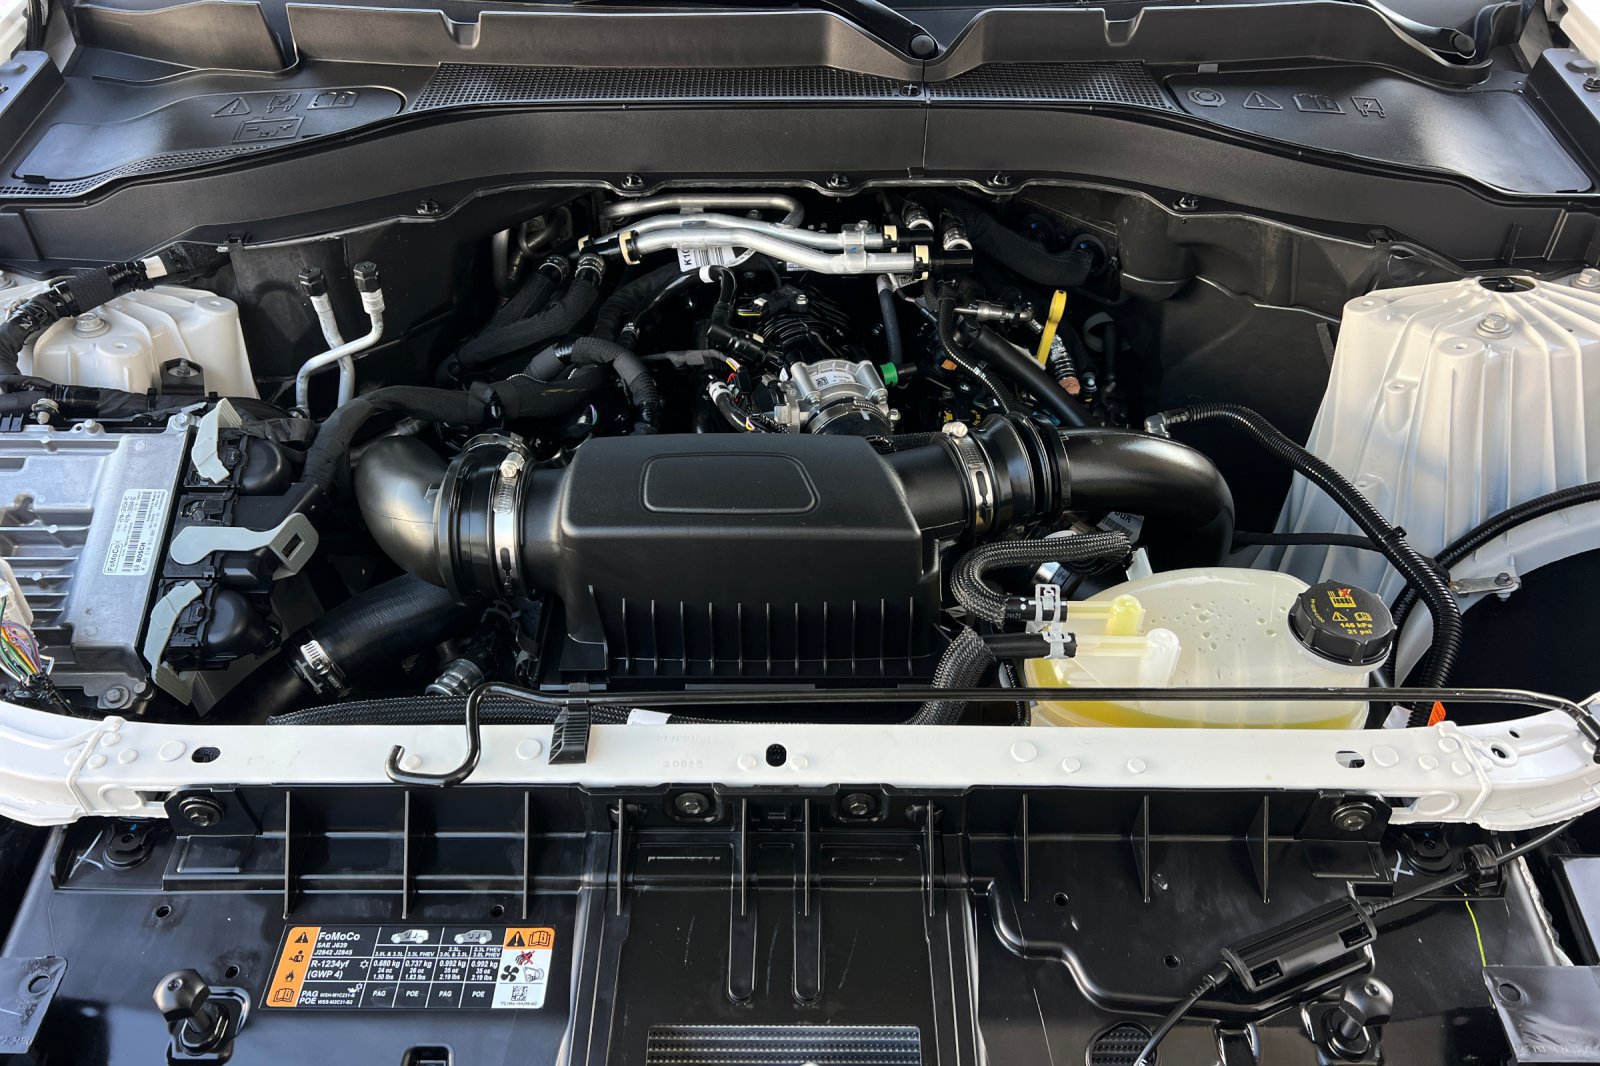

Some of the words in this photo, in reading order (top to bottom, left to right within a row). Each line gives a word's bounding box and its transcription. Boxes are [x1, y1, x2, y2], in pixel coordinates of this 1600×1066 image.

[136, 542, 146, 563] BOSCH
[108, 544, 120, 571] FoMoCo
[318, 932, 360, 941] FoMoCo
[311, 959, 350, 969] R-1234yf
[391, 960, 400, 968] kg
[423, 960, 432, 968] kg
[457, 960, 466, 968] kg
[471, 960, 489, 968] 0.992
[489, 960, 498, 969] kg
[307, 970, 333, 980] (GWP
[333, 970, 343, 980] 4)
[471, 990, 486, 998] POE
